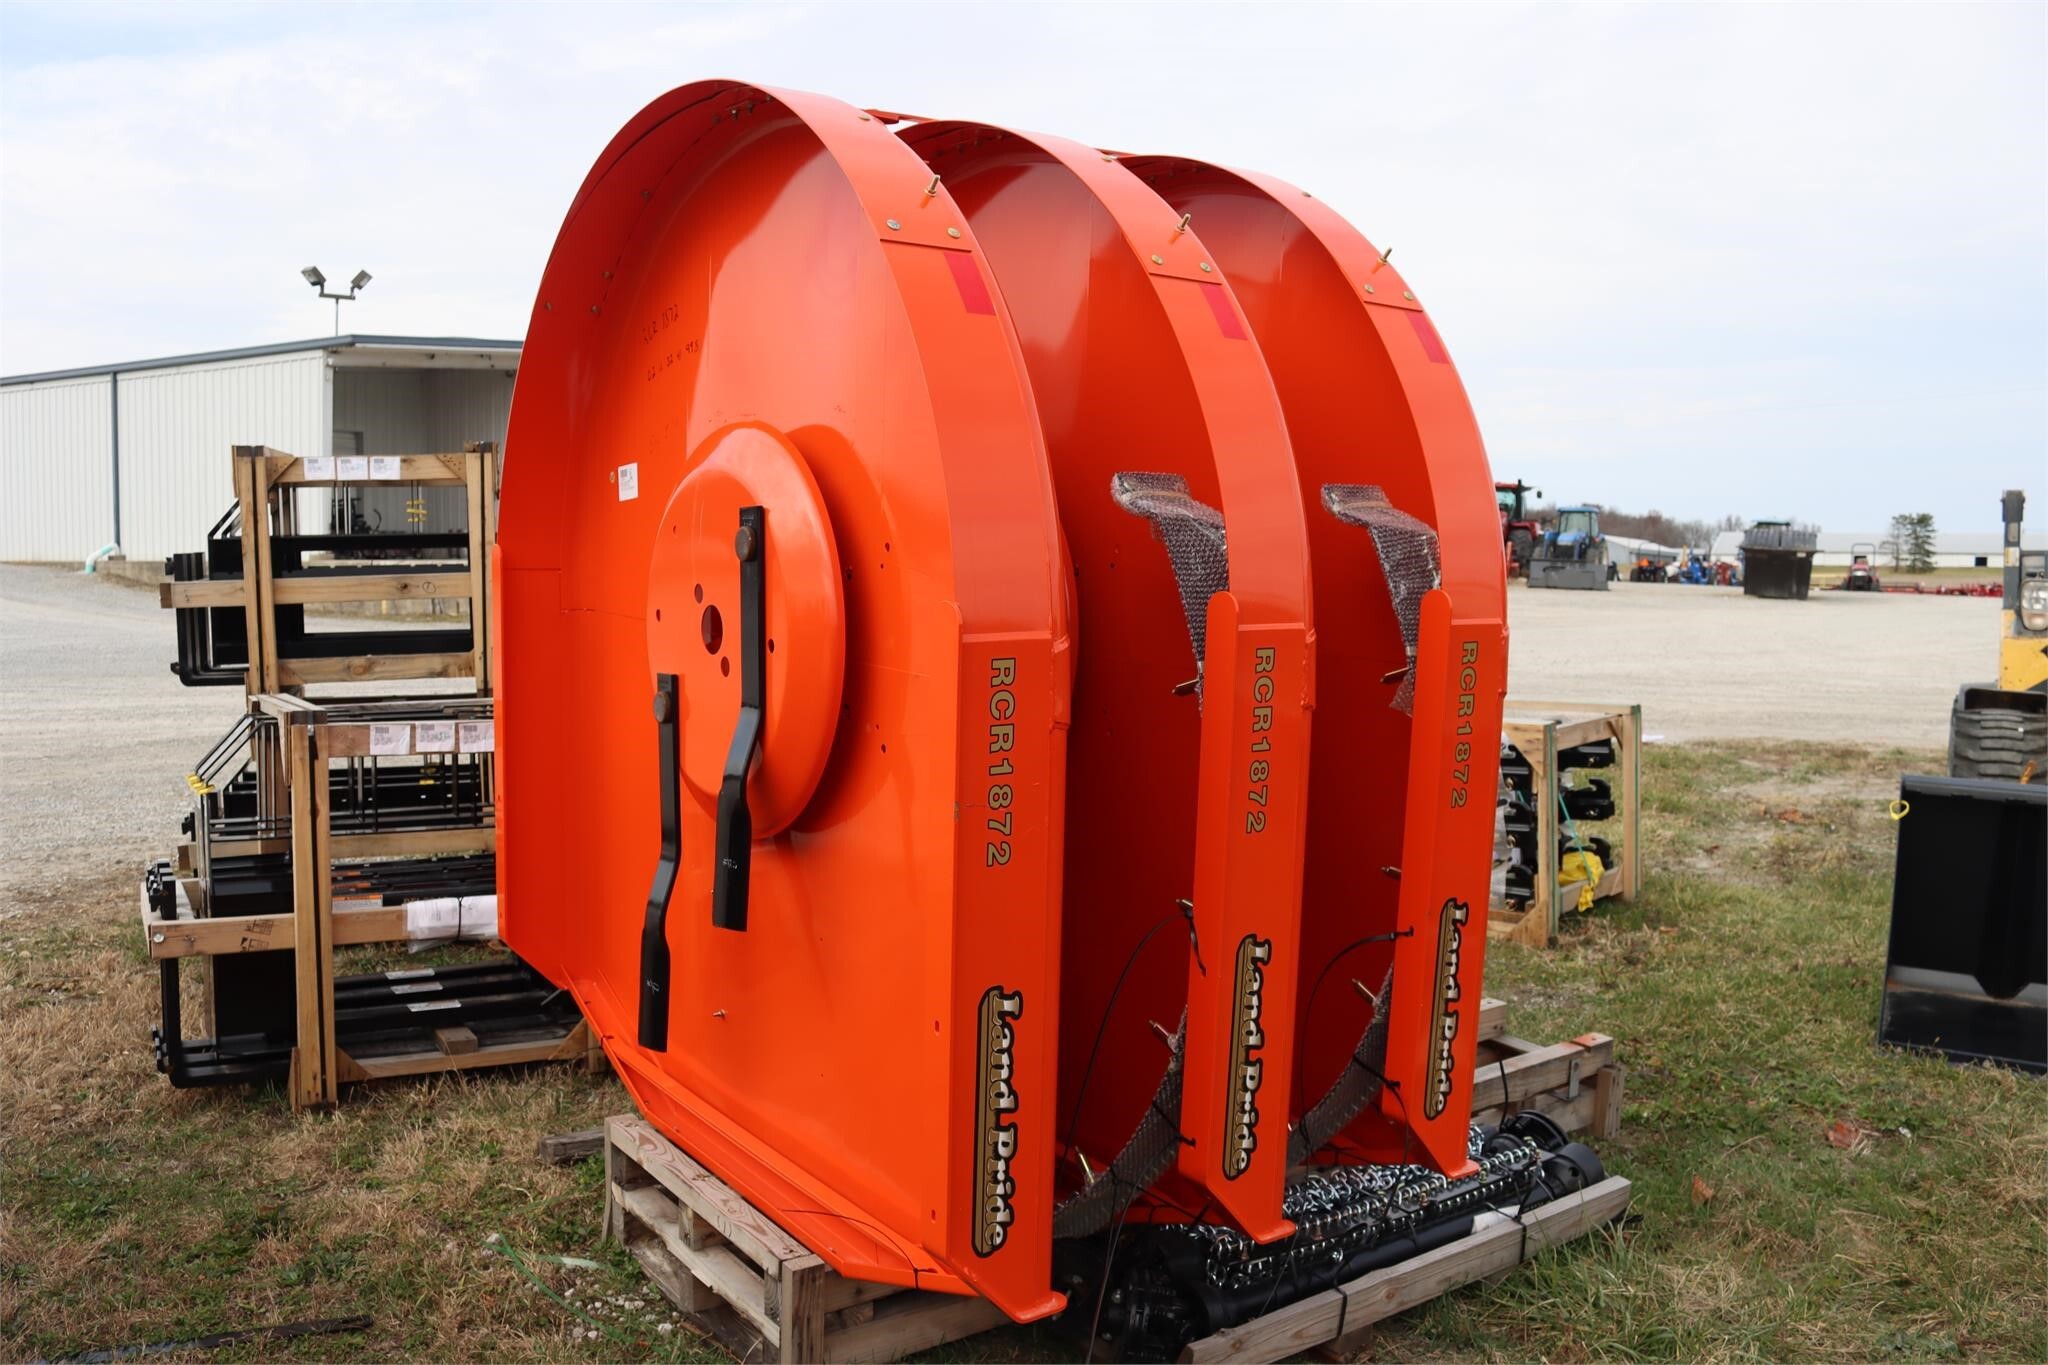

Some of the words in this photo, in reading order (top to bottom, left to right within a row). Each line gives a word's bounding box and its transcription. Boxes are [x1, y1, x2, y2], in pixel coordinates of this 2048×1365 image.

[986, 657, 1017, 868] RCR1872
[1246, 647, 1275, 834] RCR1872
[1451, 641, 1478, 808] RCR1872
[1240, 943, 1269, 1048] Land
[1442, 906, 1466, 1000] Land
[990, 993, 1021, 1112] Land
[1432, 1014, 1457, 1111] Pride
[1232, 1061, 1260, 1171] Pride
[985, 1126, 1016, 1247] Pride
